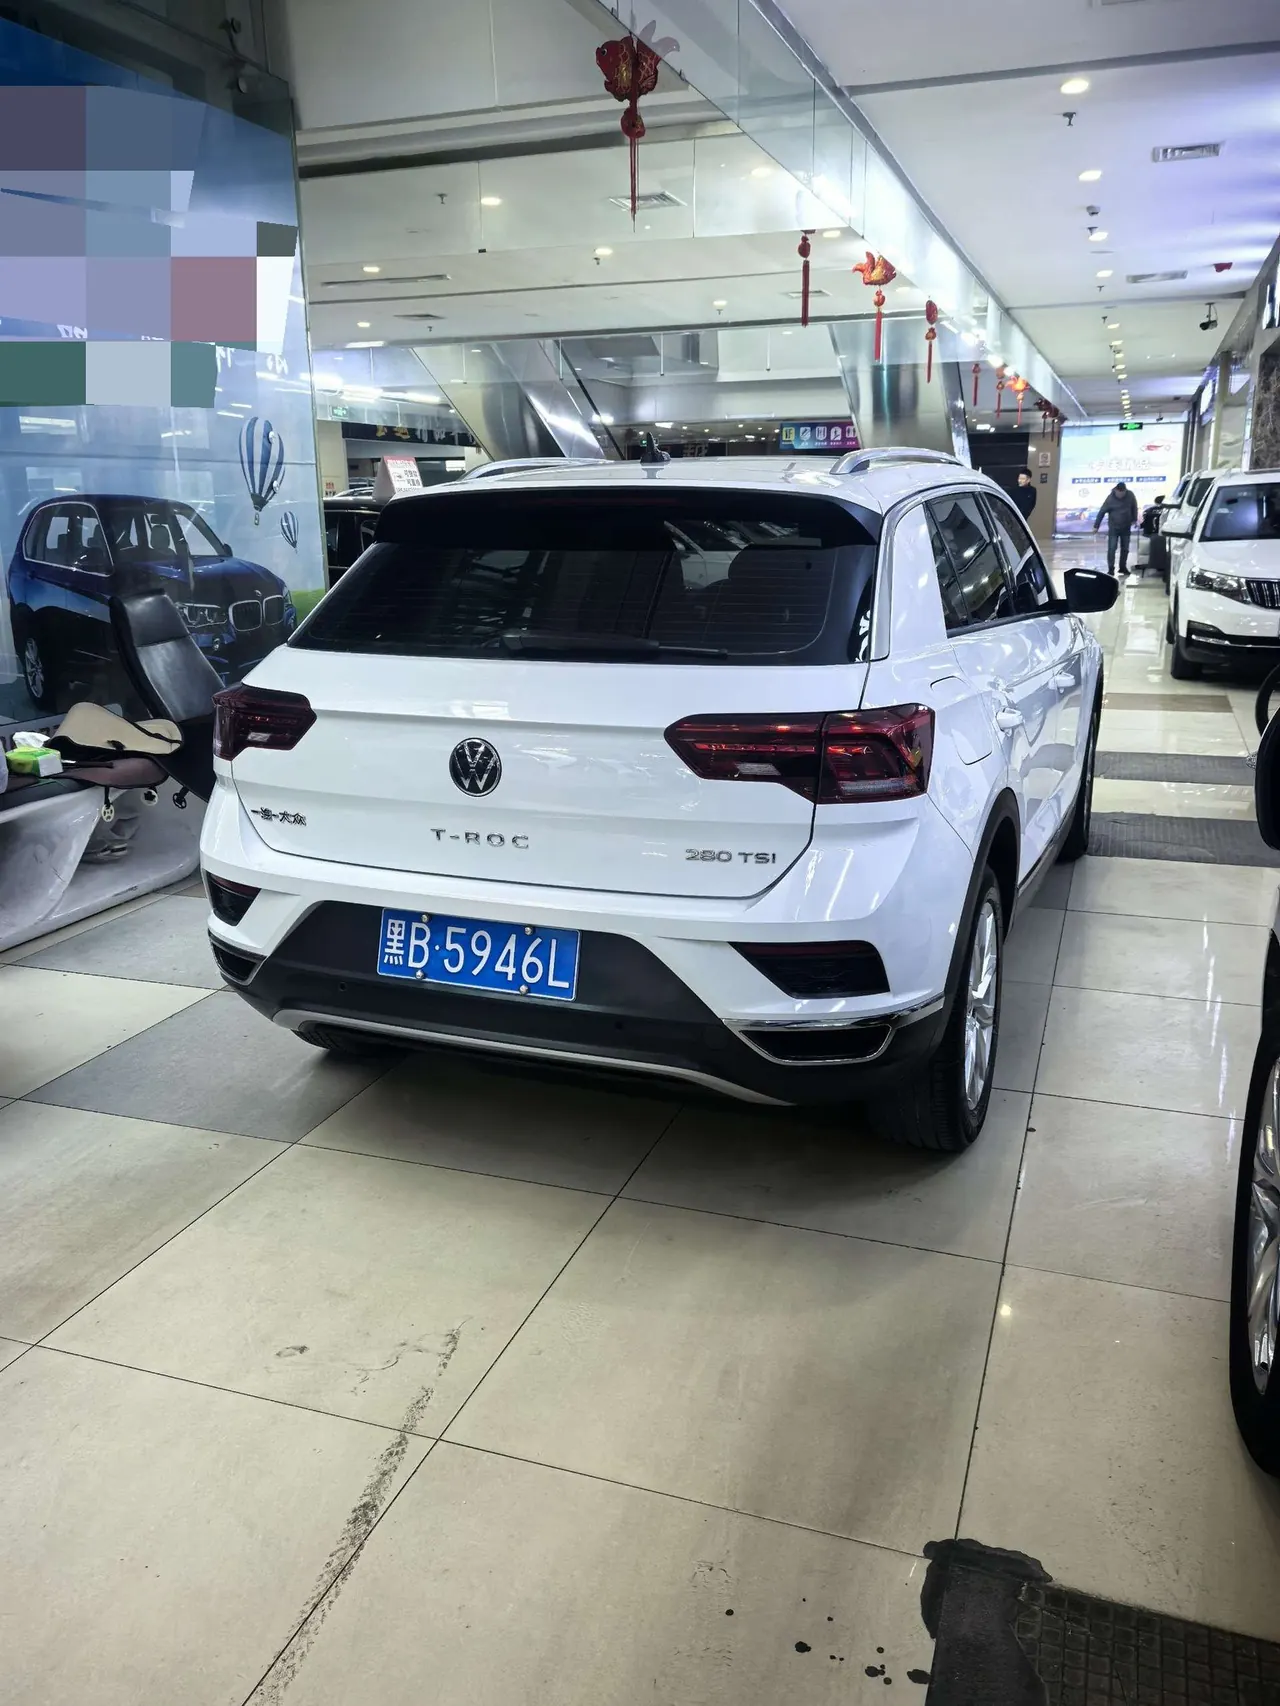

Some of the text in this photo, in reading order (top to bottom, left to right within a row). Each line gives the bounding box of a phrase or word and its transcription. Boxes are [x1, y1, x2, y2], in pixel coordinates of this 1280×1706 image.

[430, 827, 529, 850] T-ROC
[684, 848, 776, 864] 280 TSI
[383, 918, 571, 990] 黑B·5946L
